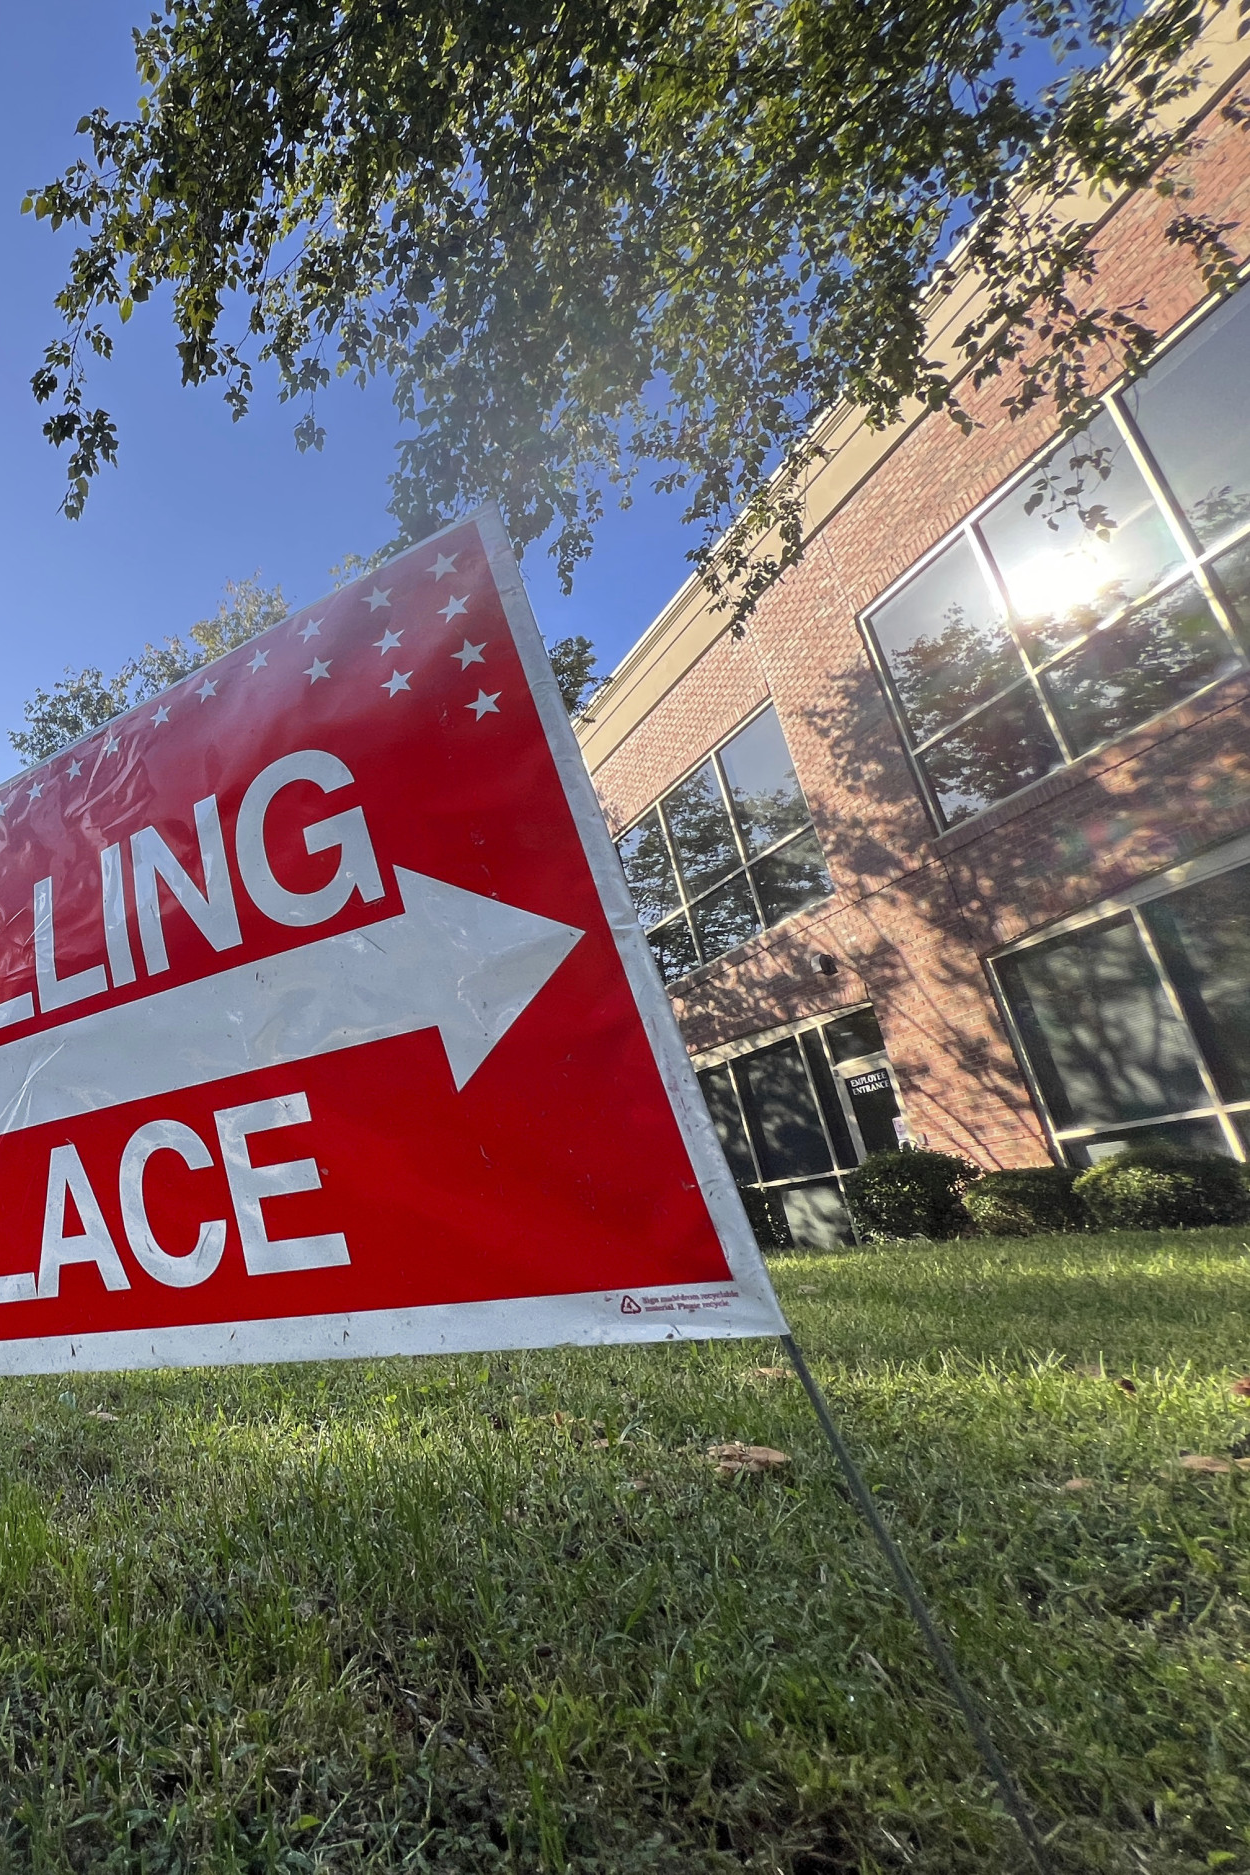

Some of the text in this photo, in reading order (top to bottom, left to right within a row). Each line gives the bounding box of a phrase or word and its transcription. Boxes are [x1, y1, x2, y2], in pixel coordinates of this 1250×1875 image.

[850, 1071, 887, 1088] EMPLOYEE
[852, 1080, 890, 1096] ENTRANCE
[701, 1290, 740, 1300] recyclable
